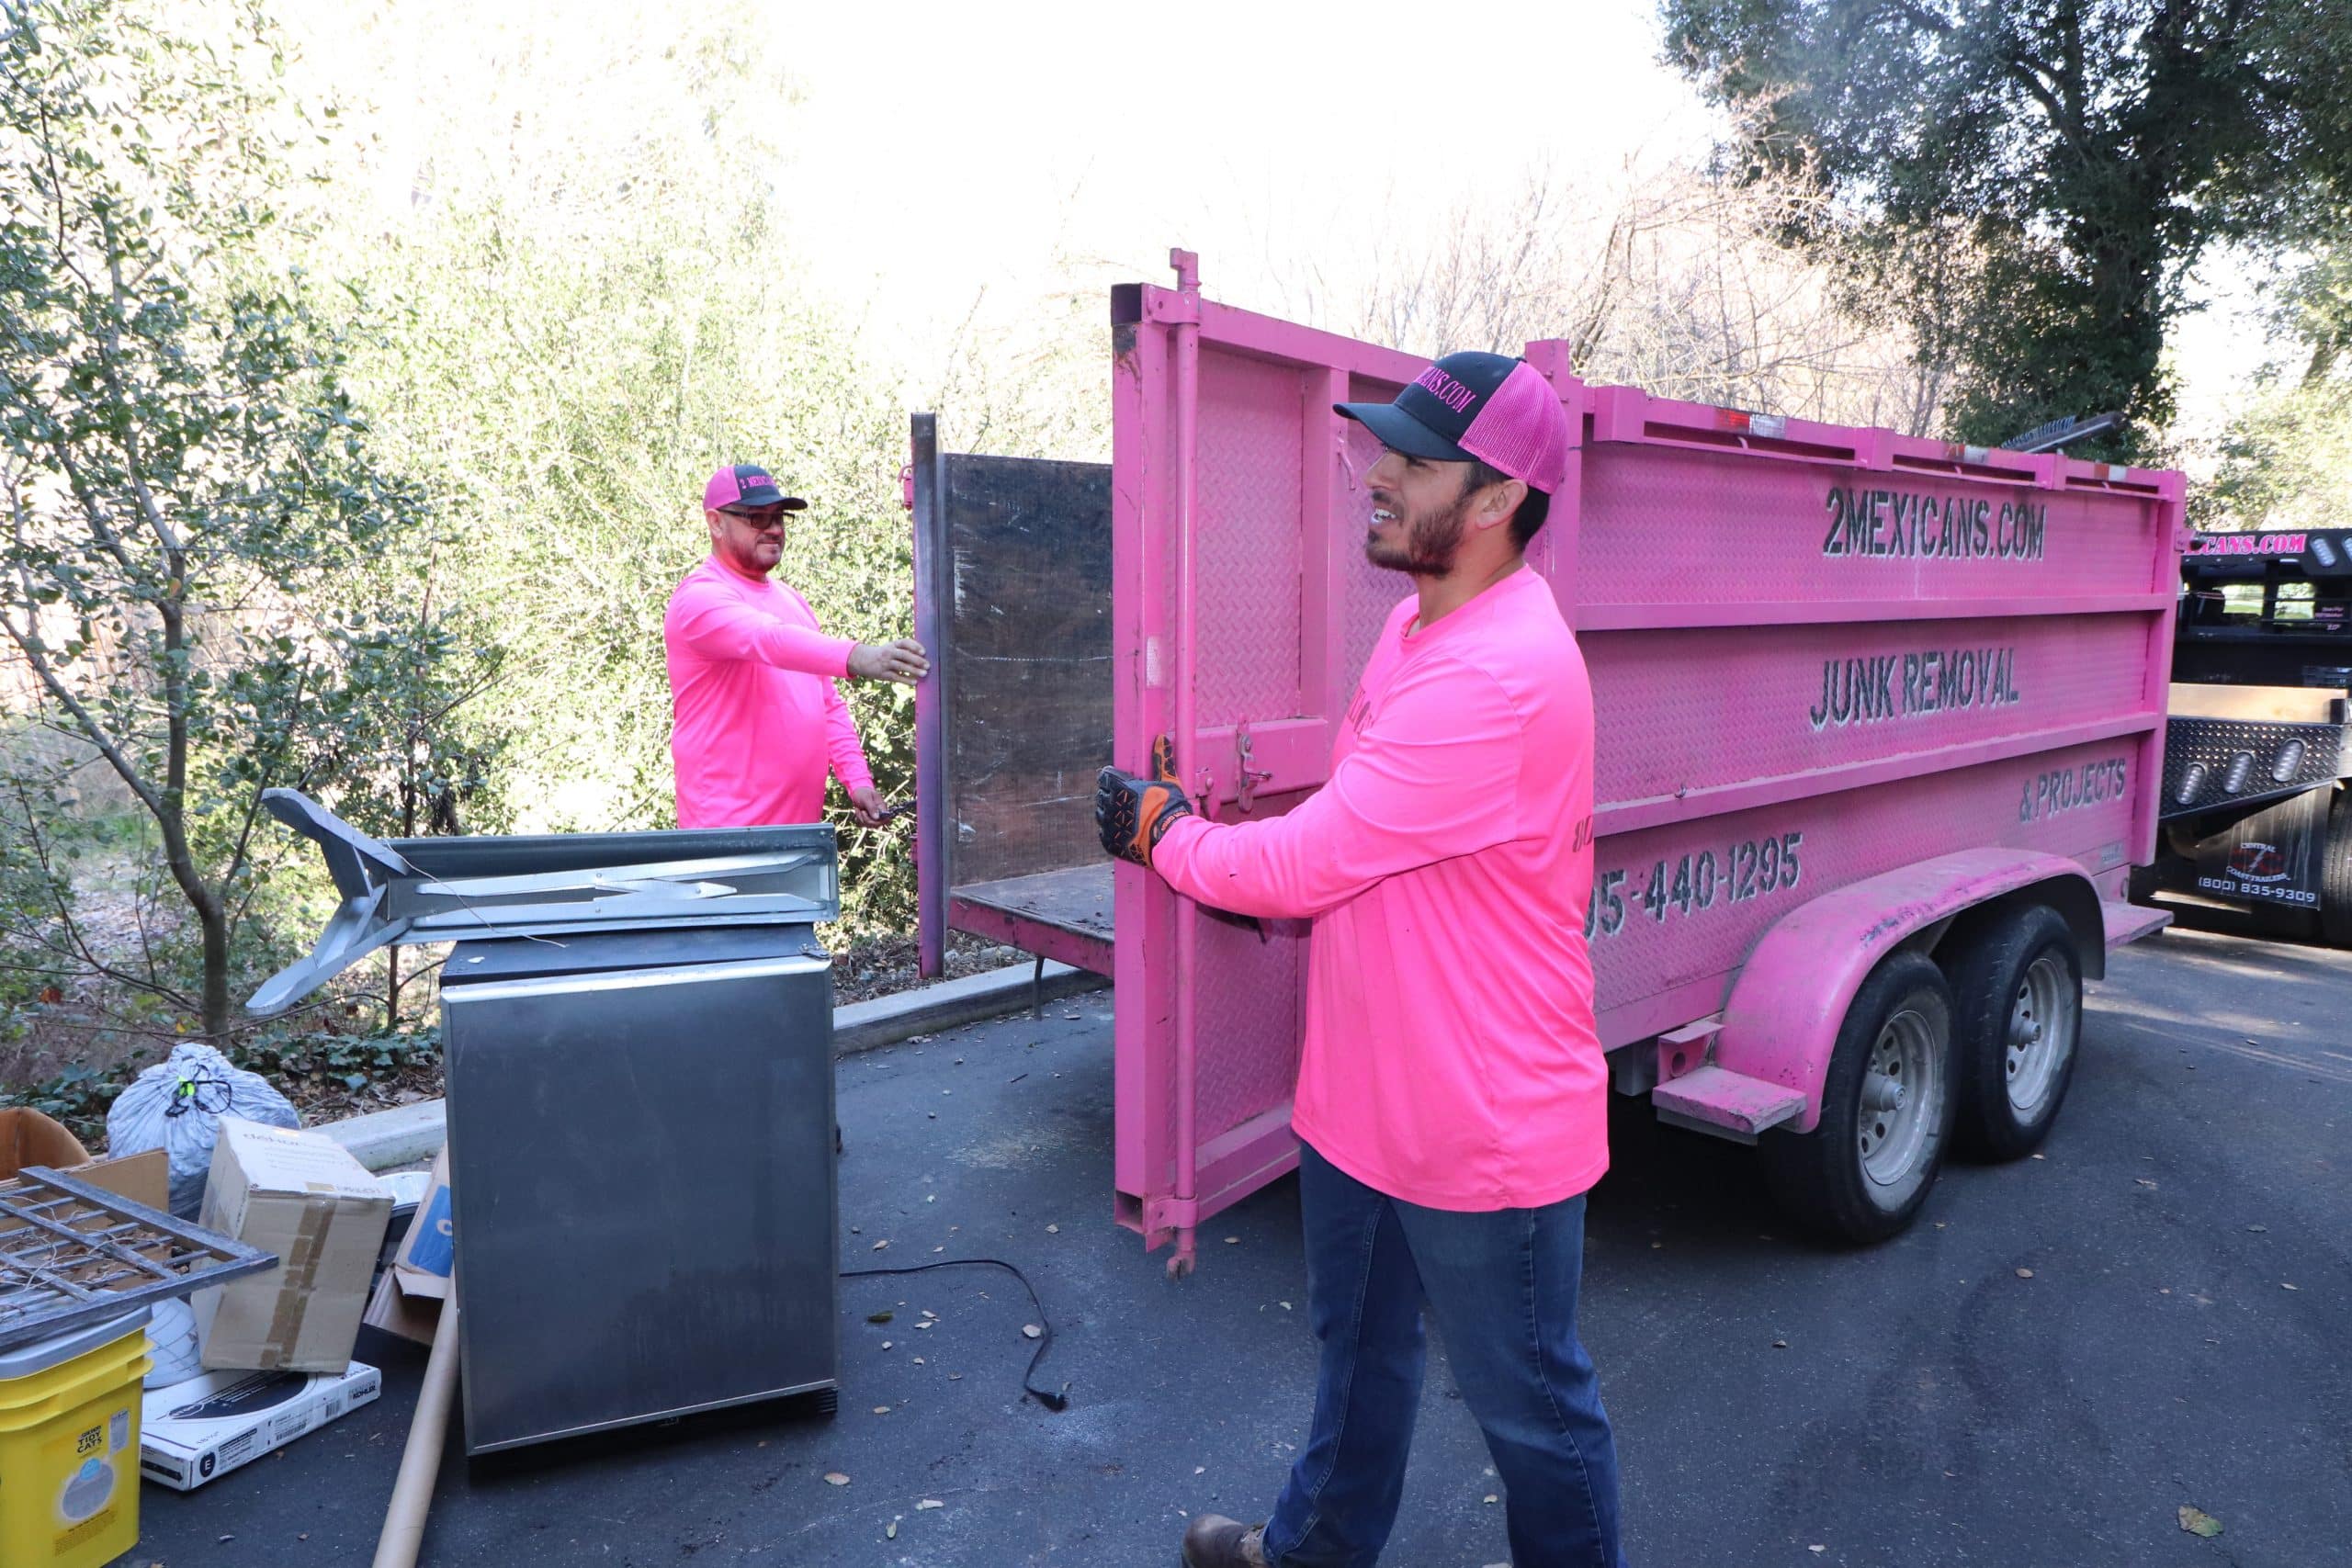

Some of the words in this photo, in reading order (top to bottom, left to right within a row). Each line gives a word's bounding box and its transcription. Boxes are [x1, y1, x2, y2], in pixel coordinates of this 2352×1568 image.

[1823, 487, 2047, 561] 2MEXICANS.COM
[1810, 655, 1896, 733] JUNK
[1902, 647, 2019, 719] REMOVAL
[2020, 780, 2032, 823] &
[2035, 757, 2126, 819] PROJECTS
[2241, 841, 2278, 853] CENTRAL
[2198, 876, 2236, 892] (800)
[2240, 883, 2316, 903] 835-9309
[352, 1384, 377, 1401] KOHLER
[76, 1437, 103, 1453] CATS
[78, 1429, 102, 1446] TIDY
[204, 1459, 211, 1472] E
